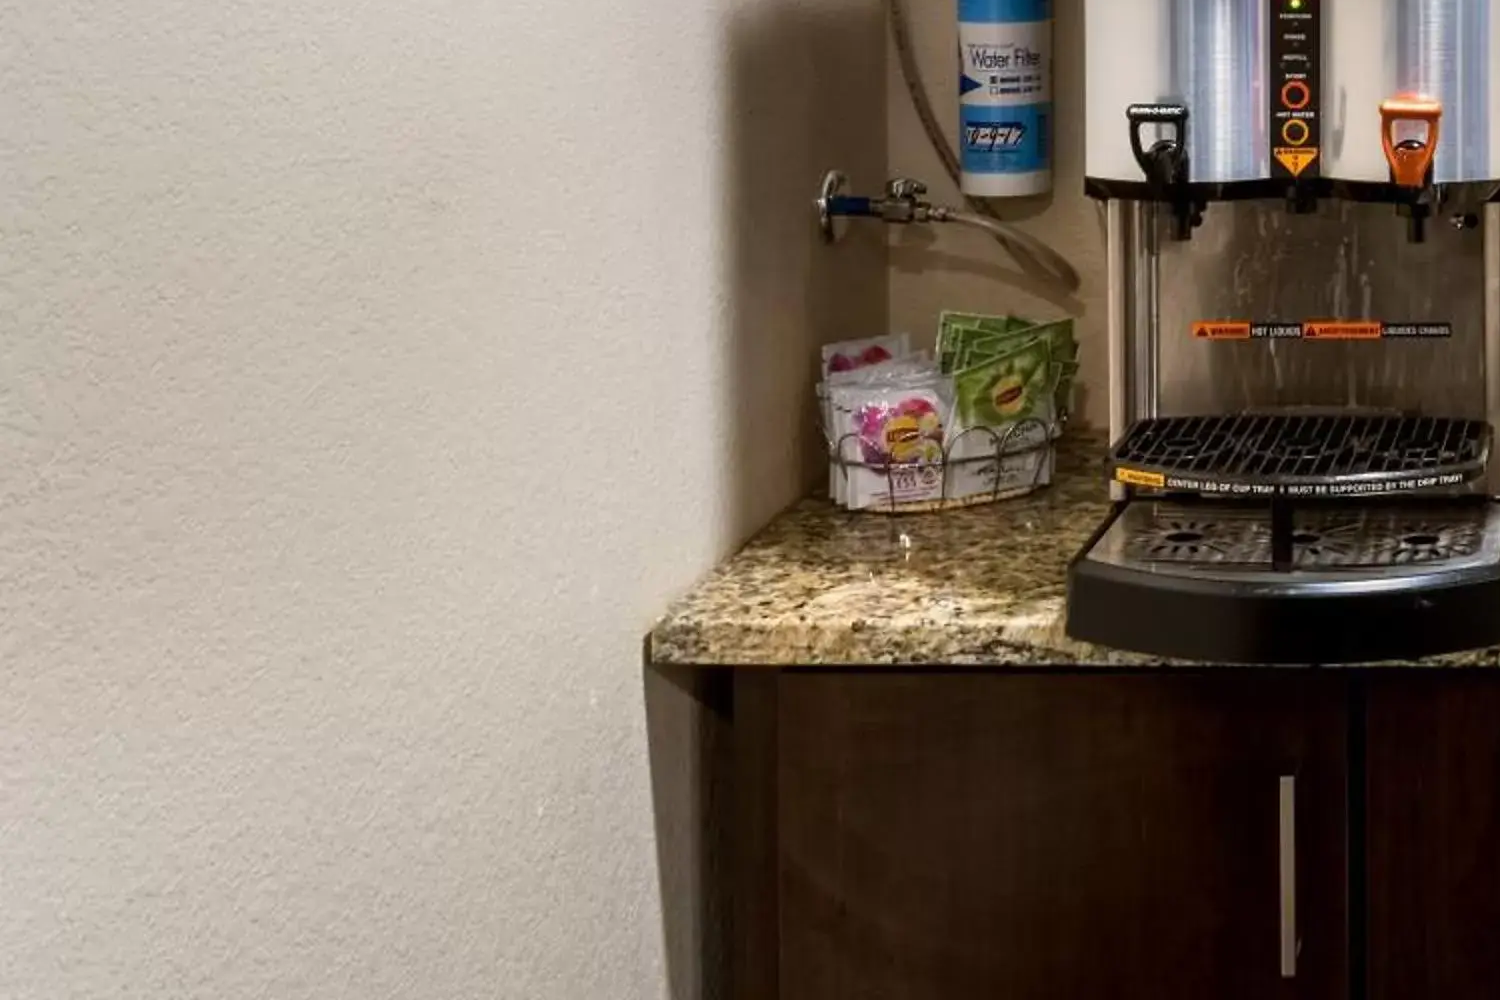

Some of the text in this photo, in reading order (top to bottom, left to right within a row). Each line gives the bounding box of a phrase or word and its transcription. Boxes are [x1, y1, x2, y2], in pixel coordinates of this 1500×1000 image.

[968, 48, 1042, 69] Water Filter
[1167, 477, 1199, 489] CENTER
[1288, 484, 1314, 494] MUST
[1315, 484, 1328, 494] BE
[1330, 482, 1384, 494] SUPPORTED
[1385, 480, 1399, 491] BY
[1400, 479, 1416, 490] THE
[1418, 476, 1437, 487] DRIP
